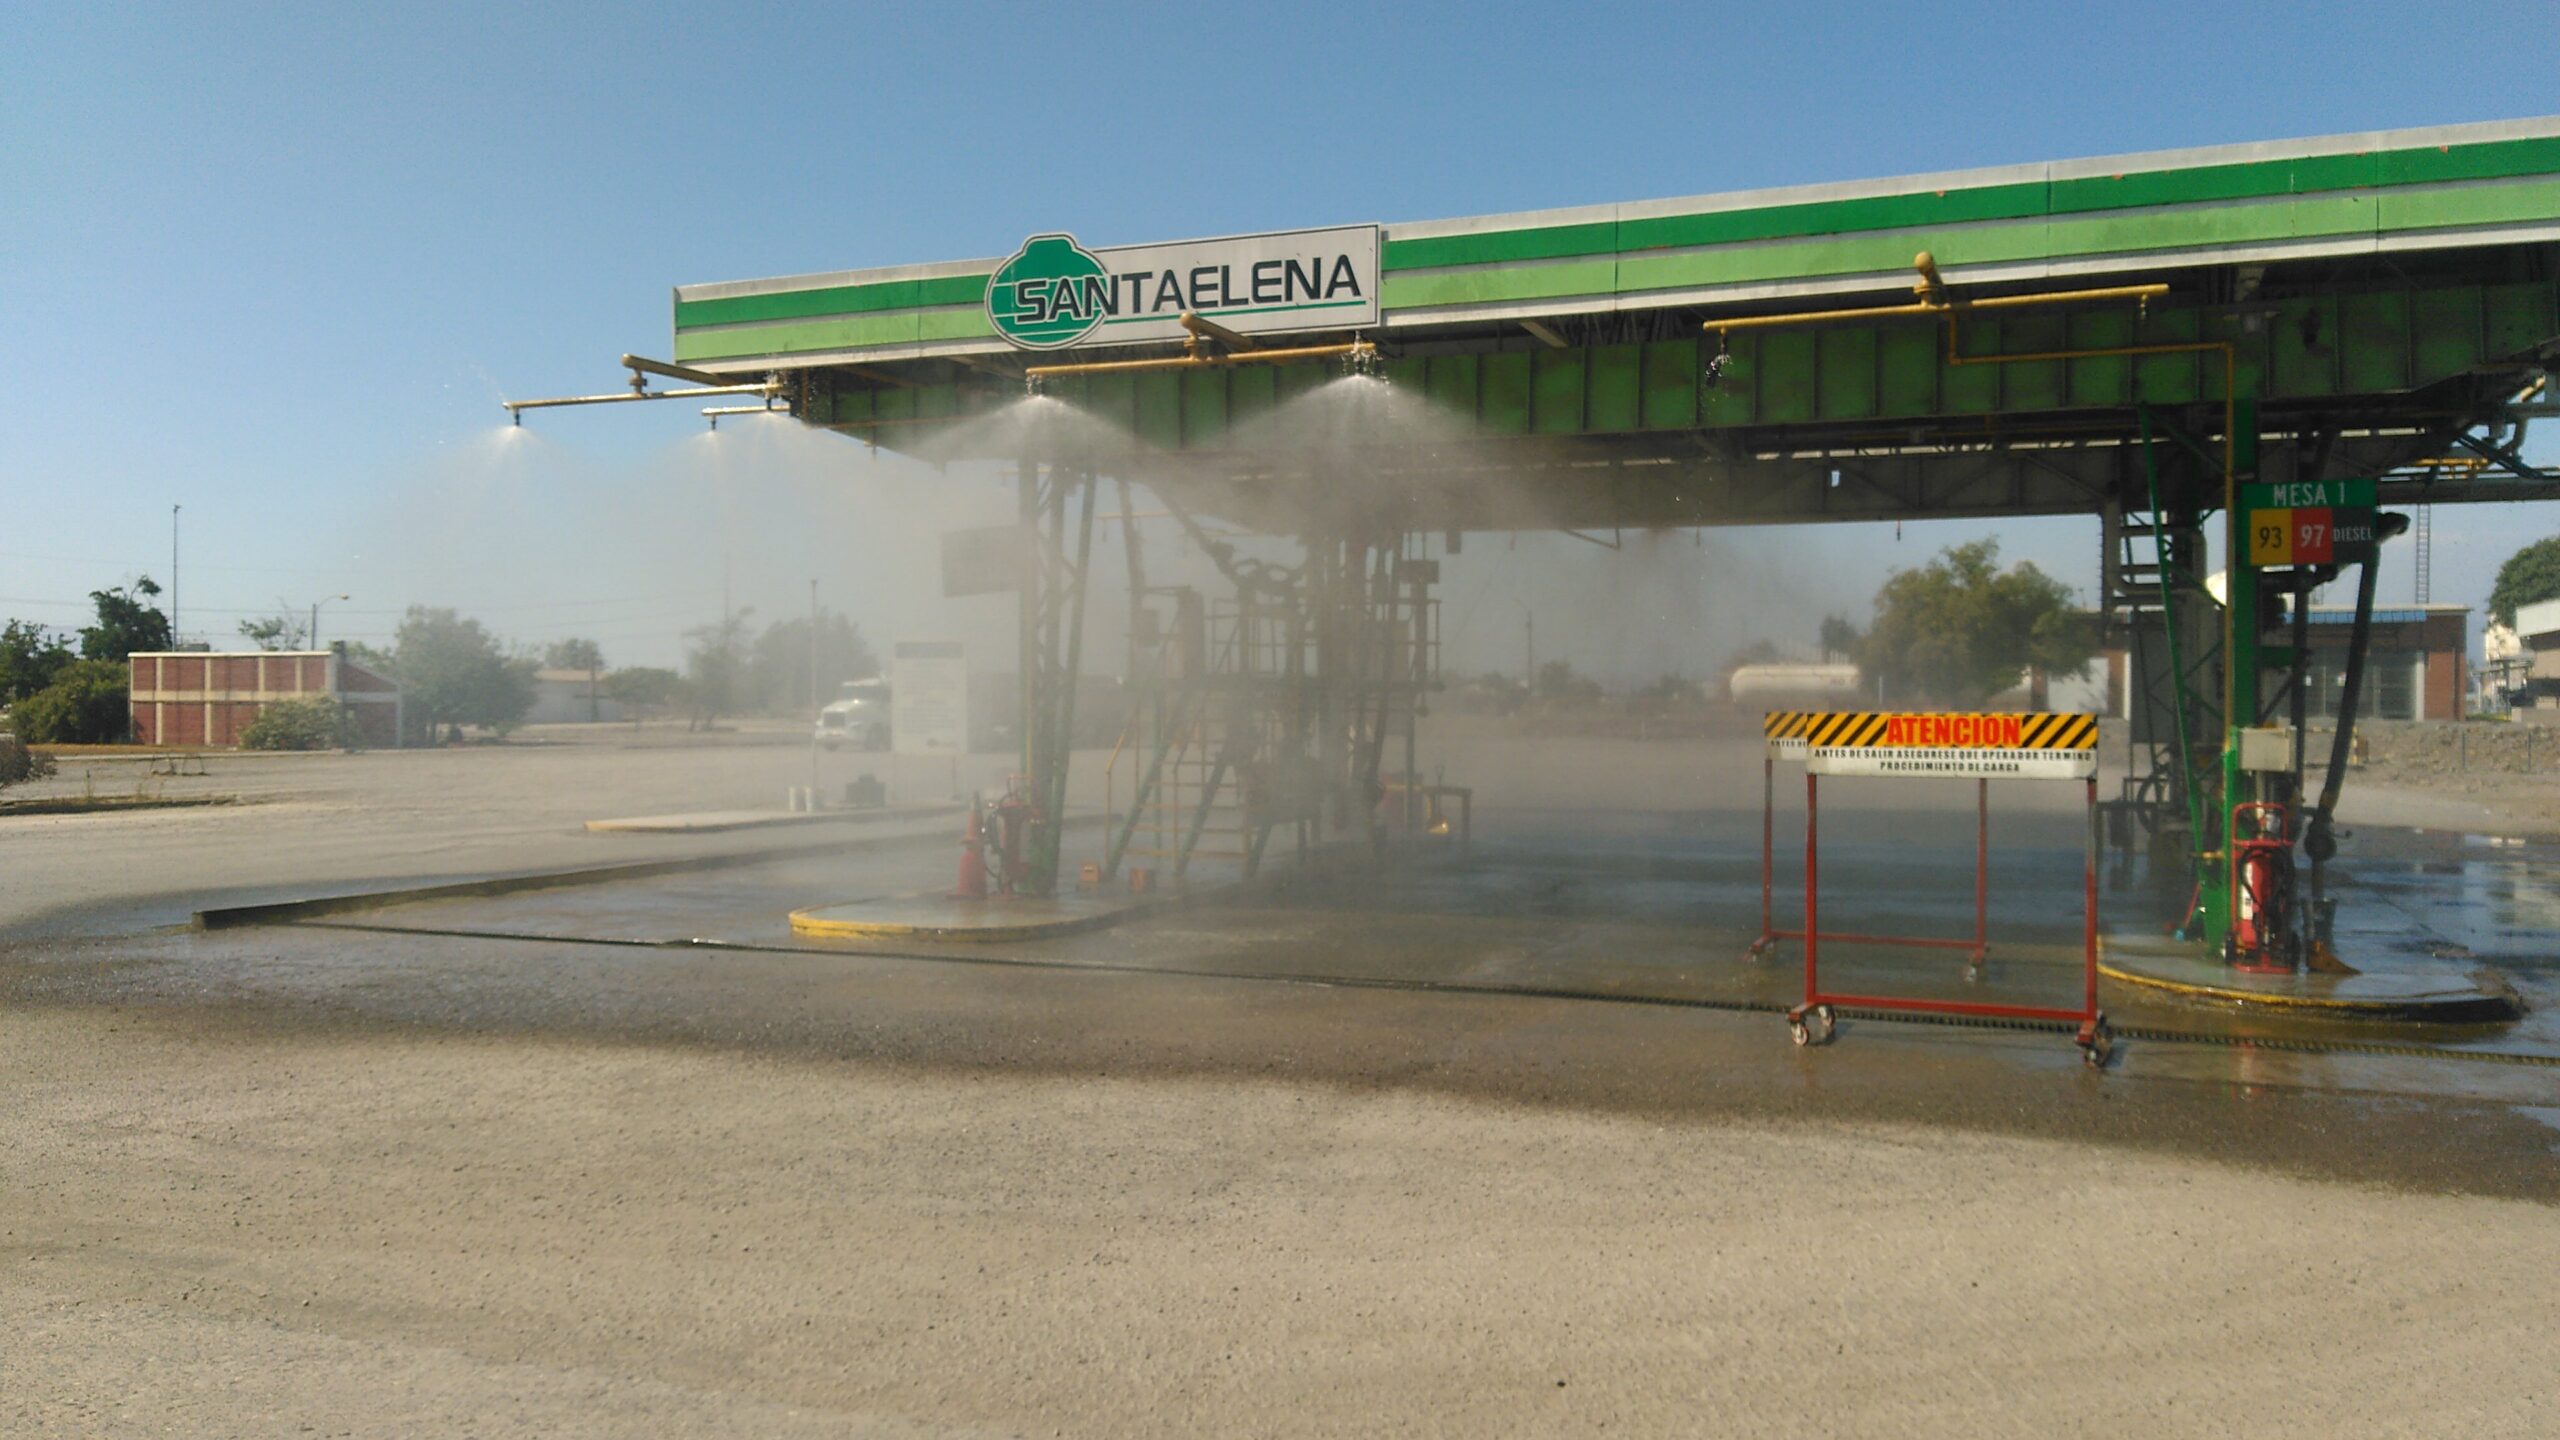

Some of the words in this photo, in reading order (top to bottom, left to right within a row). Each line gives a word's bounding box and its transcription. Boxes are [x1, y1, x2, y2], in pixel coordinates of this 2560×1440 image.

[2273, 484, 2327, 507] MESA
[2338, 482, 2346, 504] 1
[2259, 526, 2283, 548] 93
[2301, 524, 2325, 548] 97
[2333, 526, 2372, 542] DIESEL
[1887, 717, 2021, 745] ATENCION
[1815, 750, 1846, 758] ANTES
[1850, 750, 1861, 758] DE
[1865, 750, 1893, 759] SALIR
[1897, 750, 1955, 759] ASEGURESE
[1959, 751, 1978, 760] QUE
[1982, 751, 2038, 760] OPERADOR
[2043, 752, 2091, 761] TERMINO
[1880, 762, 1964, 771] PROCEDIMIENTO
[1968, 763, 1980, 772] DE
[1984, 763, 2020, 772] CARGA
